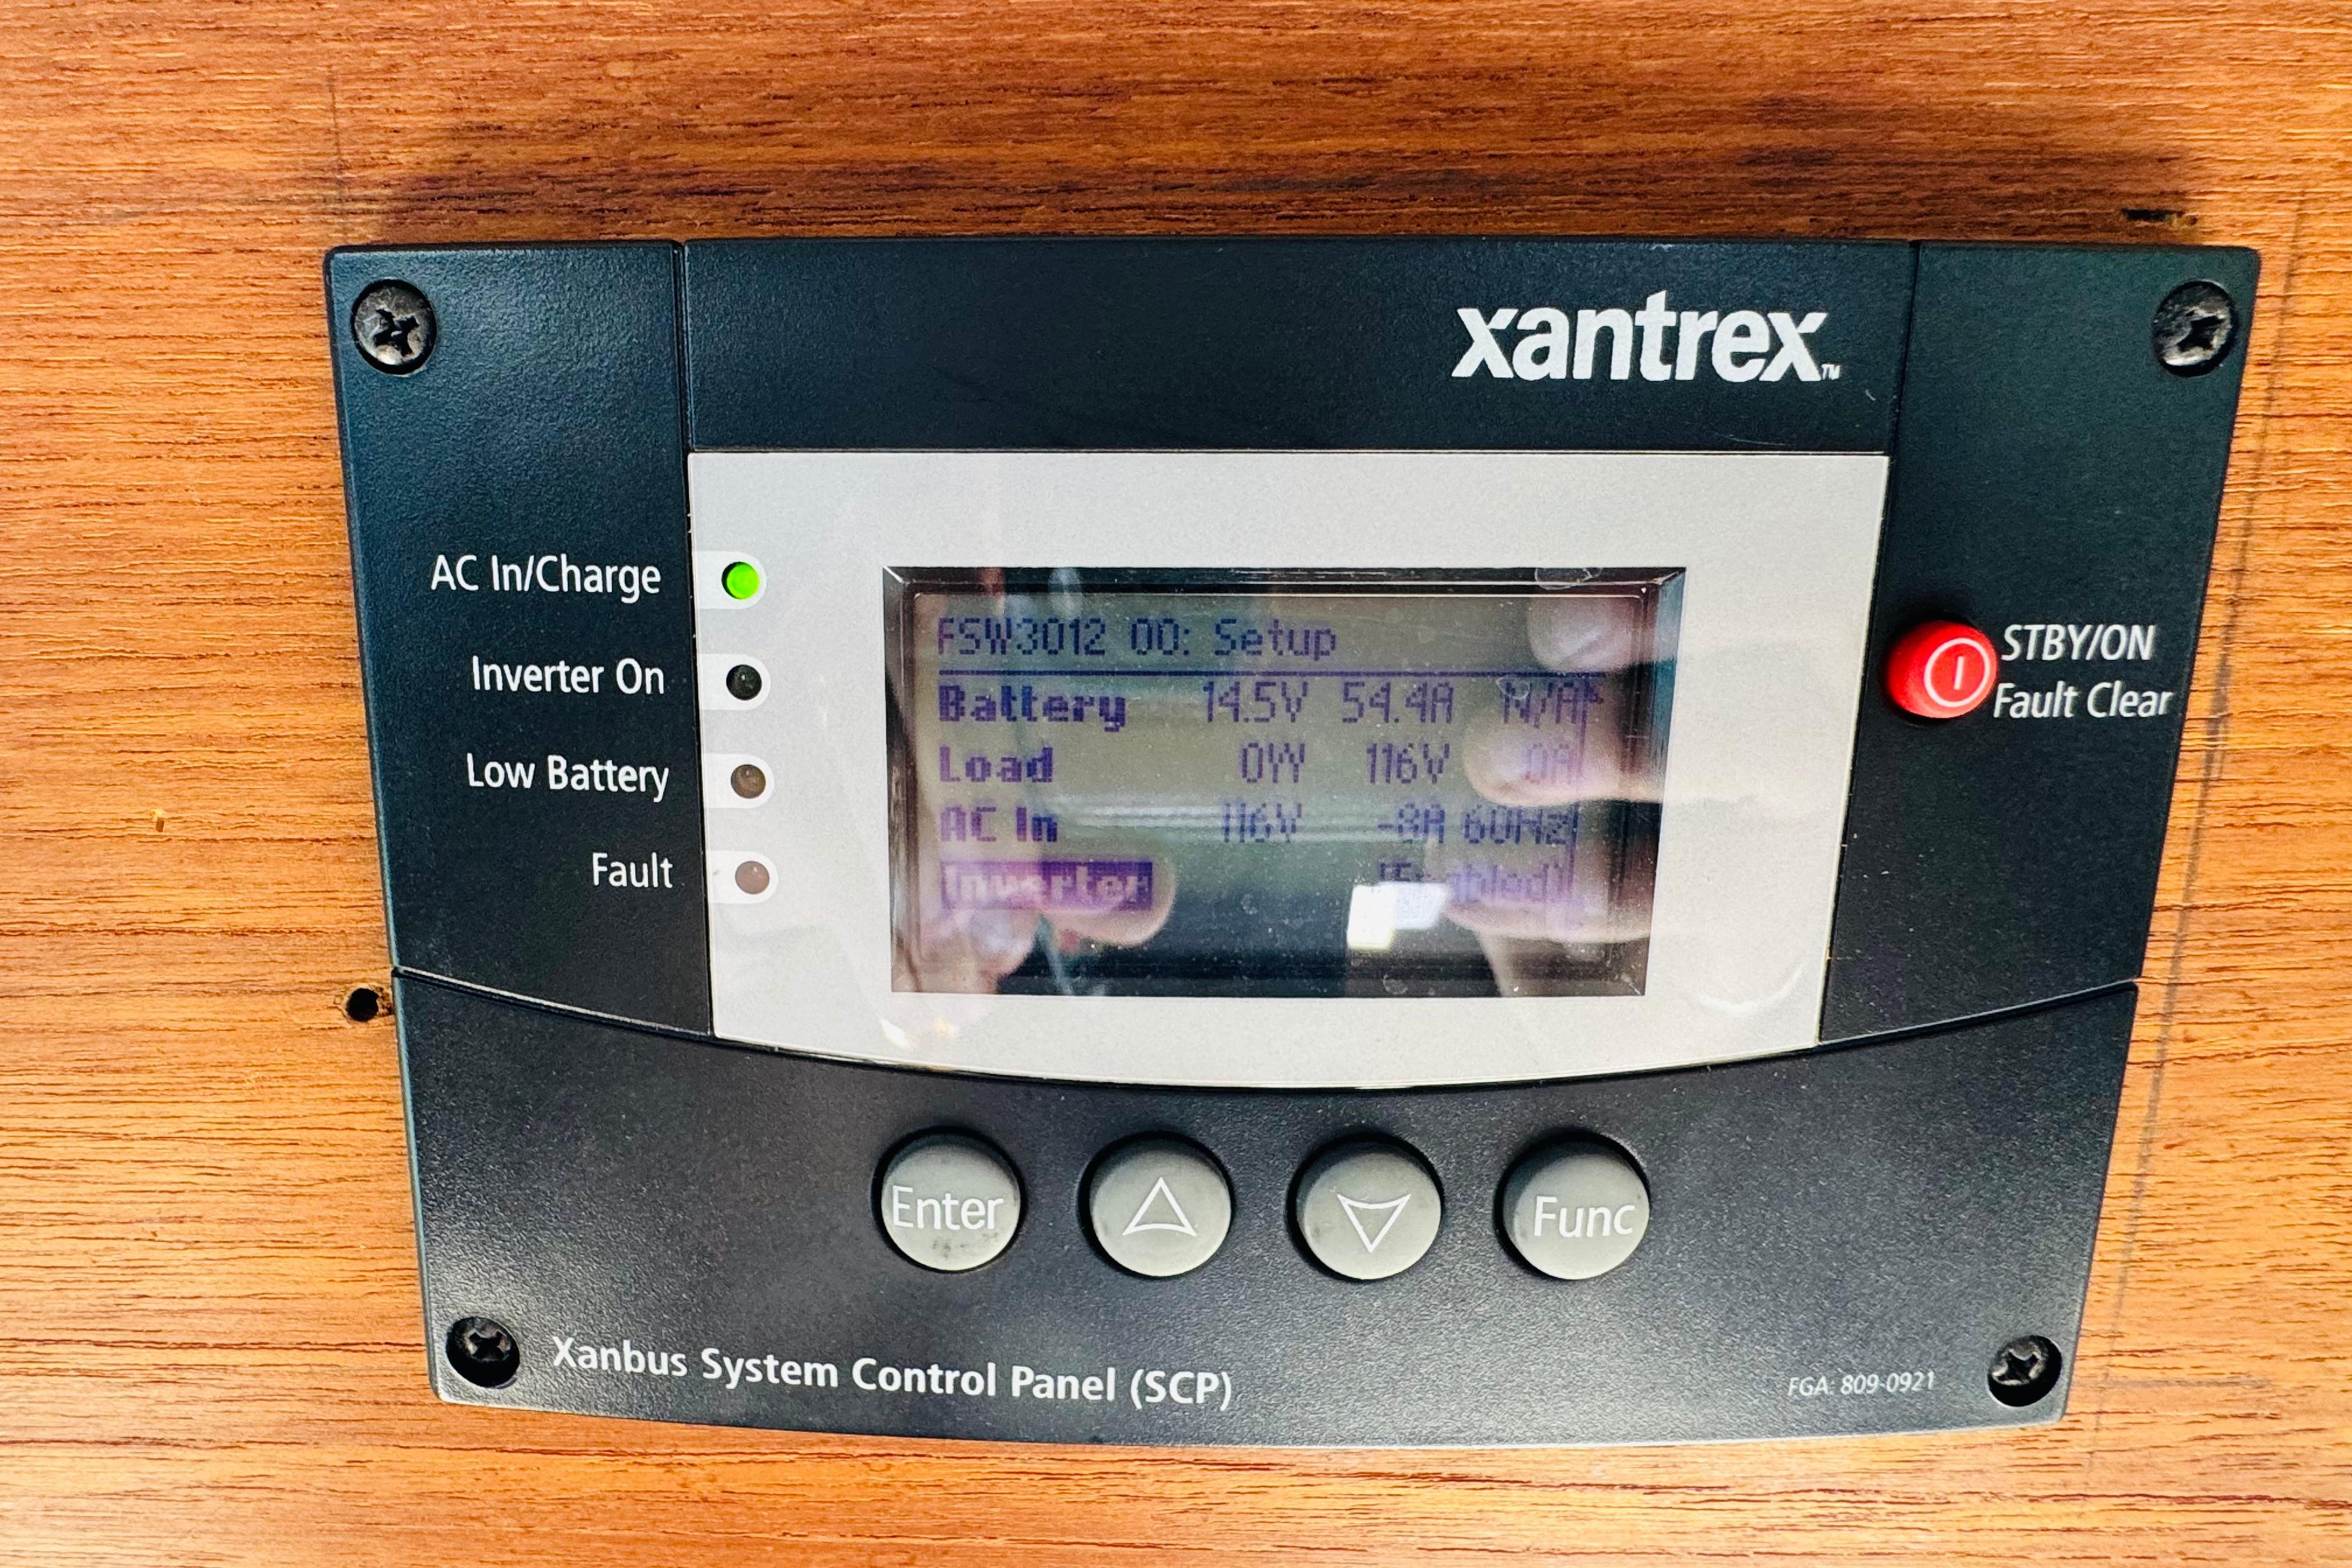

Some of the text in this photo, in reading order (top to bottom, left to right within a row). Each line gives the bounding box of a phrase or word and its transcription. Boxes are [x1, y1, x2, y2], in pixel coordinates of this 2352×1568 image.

[1451, 290, 1828, 382] xantrex
[430, 553, 662, 604] AC In/Charge
[938, 617, 1336, 661] FSW3012 00: Setup
[2001, 624, 2156, 661] STBY/ON
[473, 656, 664, 695] Inverter On
[939, 681, 1578, 732] Battery 14.5V 54.4A N/A
[1993, 680, 2175, 719] Fault Clear
[467, 753, 670, 803] Low Battery
[939, 746, 1054, 783] Load
[1366, 743, 1450, 784] 116V
[940, 806, 997, 842] AC
[1016, 806, 1058, 842] In
[1223, 803, 1303, 843] 116V
[1377, 803, 1446, 844] -8A
[593, 852, 673, 888] Fault
[944, 861, 1568, 904] Inverter [Eabled]
[892, 1185, 1003, 1231] Enter
[1534, 1196, 1636, 1238] Func
[552, 1336, 1233, 1412] Xanbus System Control Panel (SCP)
[1840, 1370, 1934, 1395] 809-0921
